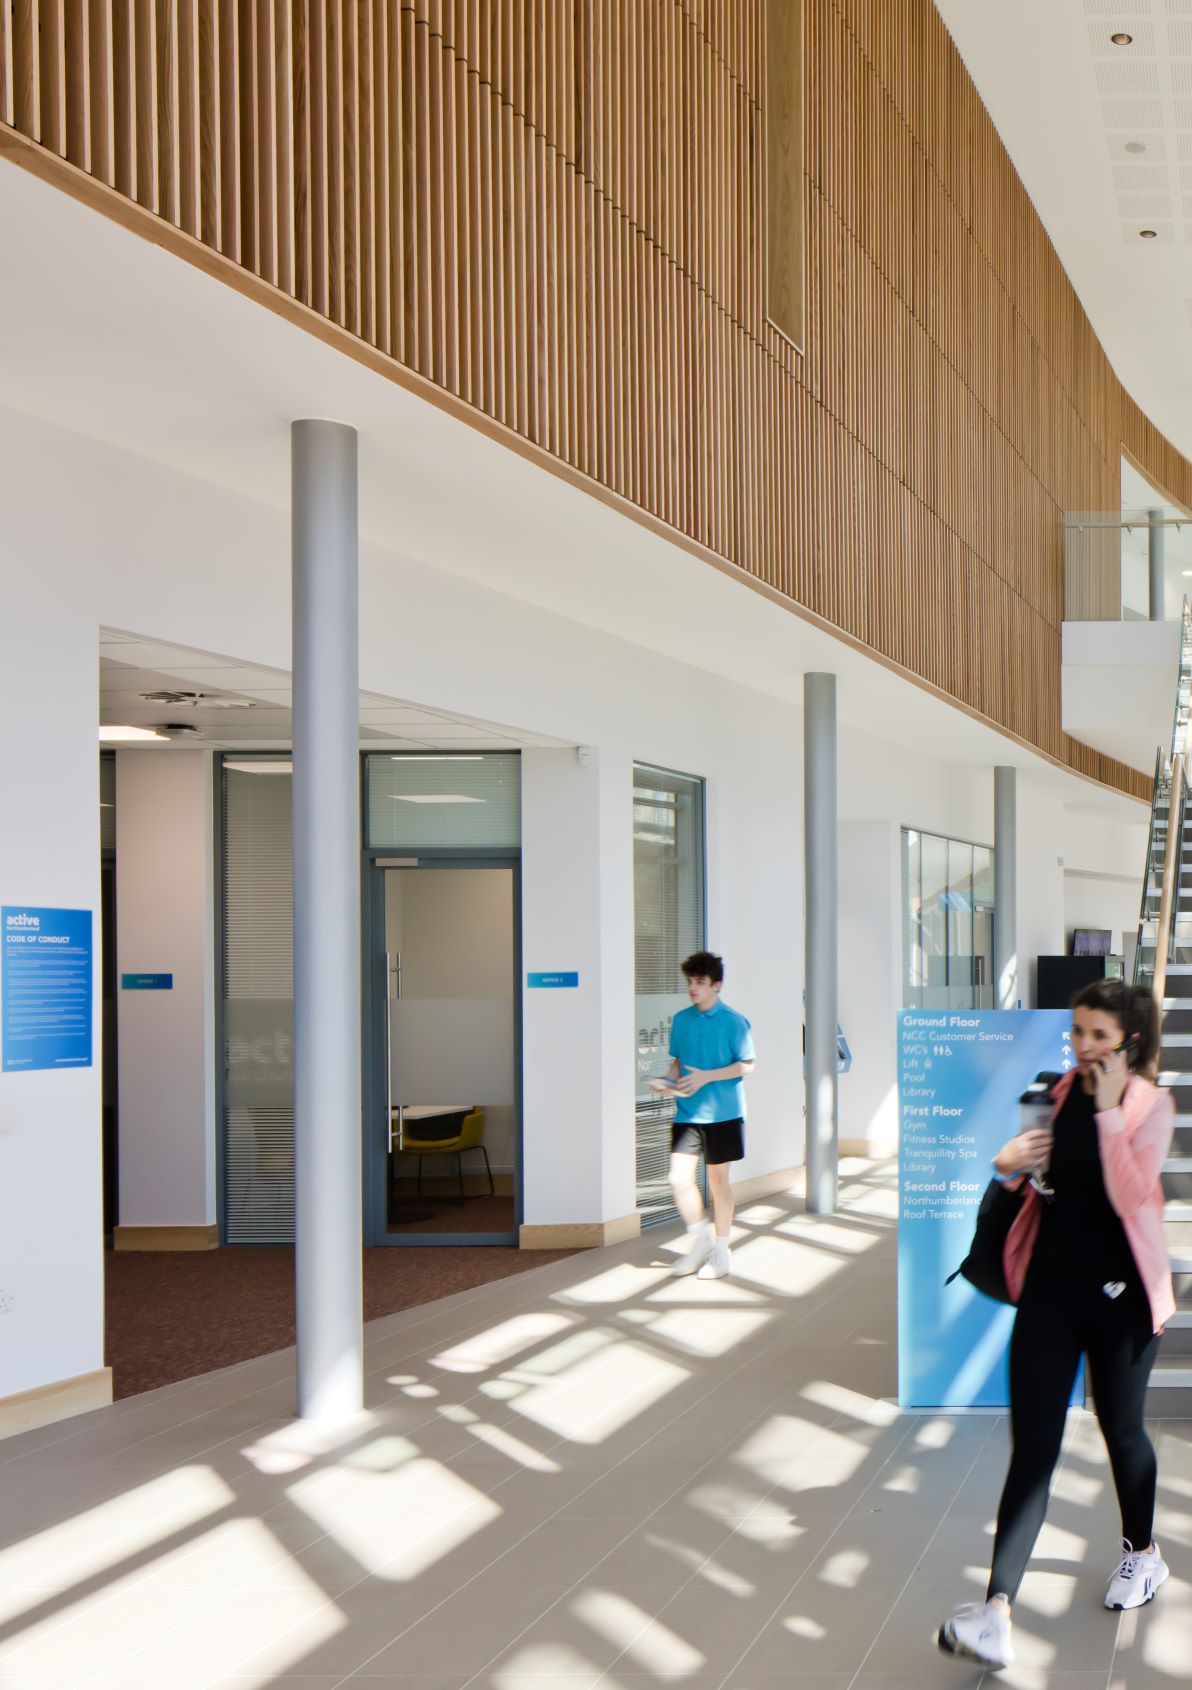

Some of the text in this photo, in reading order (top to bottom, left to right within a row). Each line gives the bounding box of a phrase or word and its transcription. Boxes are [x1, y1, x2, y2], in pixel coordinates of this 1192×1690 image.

[7, 913, 40, 925] active
[6, 935, 26, 943] CODE
[27, 935, 37, 943] OF
[904, 1016, 980, 1026] Ground Floor
[903, 1032, 1013, 1041] NCC Customer Service
[904, 1059, 918, 1069] Lift
[904, 1073, 925, 1082] Pool
[903, 1088, 936, 1098] Library
[904, 1106, 963, 1116] First Floor
[904, 1120, 926, 1131] Gym
[904, 1135, 976, 1144] Fitness Studios
[904, 1148, 977, 1159] Tranquillity Spa
[904, 1163, 936, 1174] Library
[904, 1181, 980, 1191] Second Floor
[904, 1210, 964, 1219] Roof Terrace
